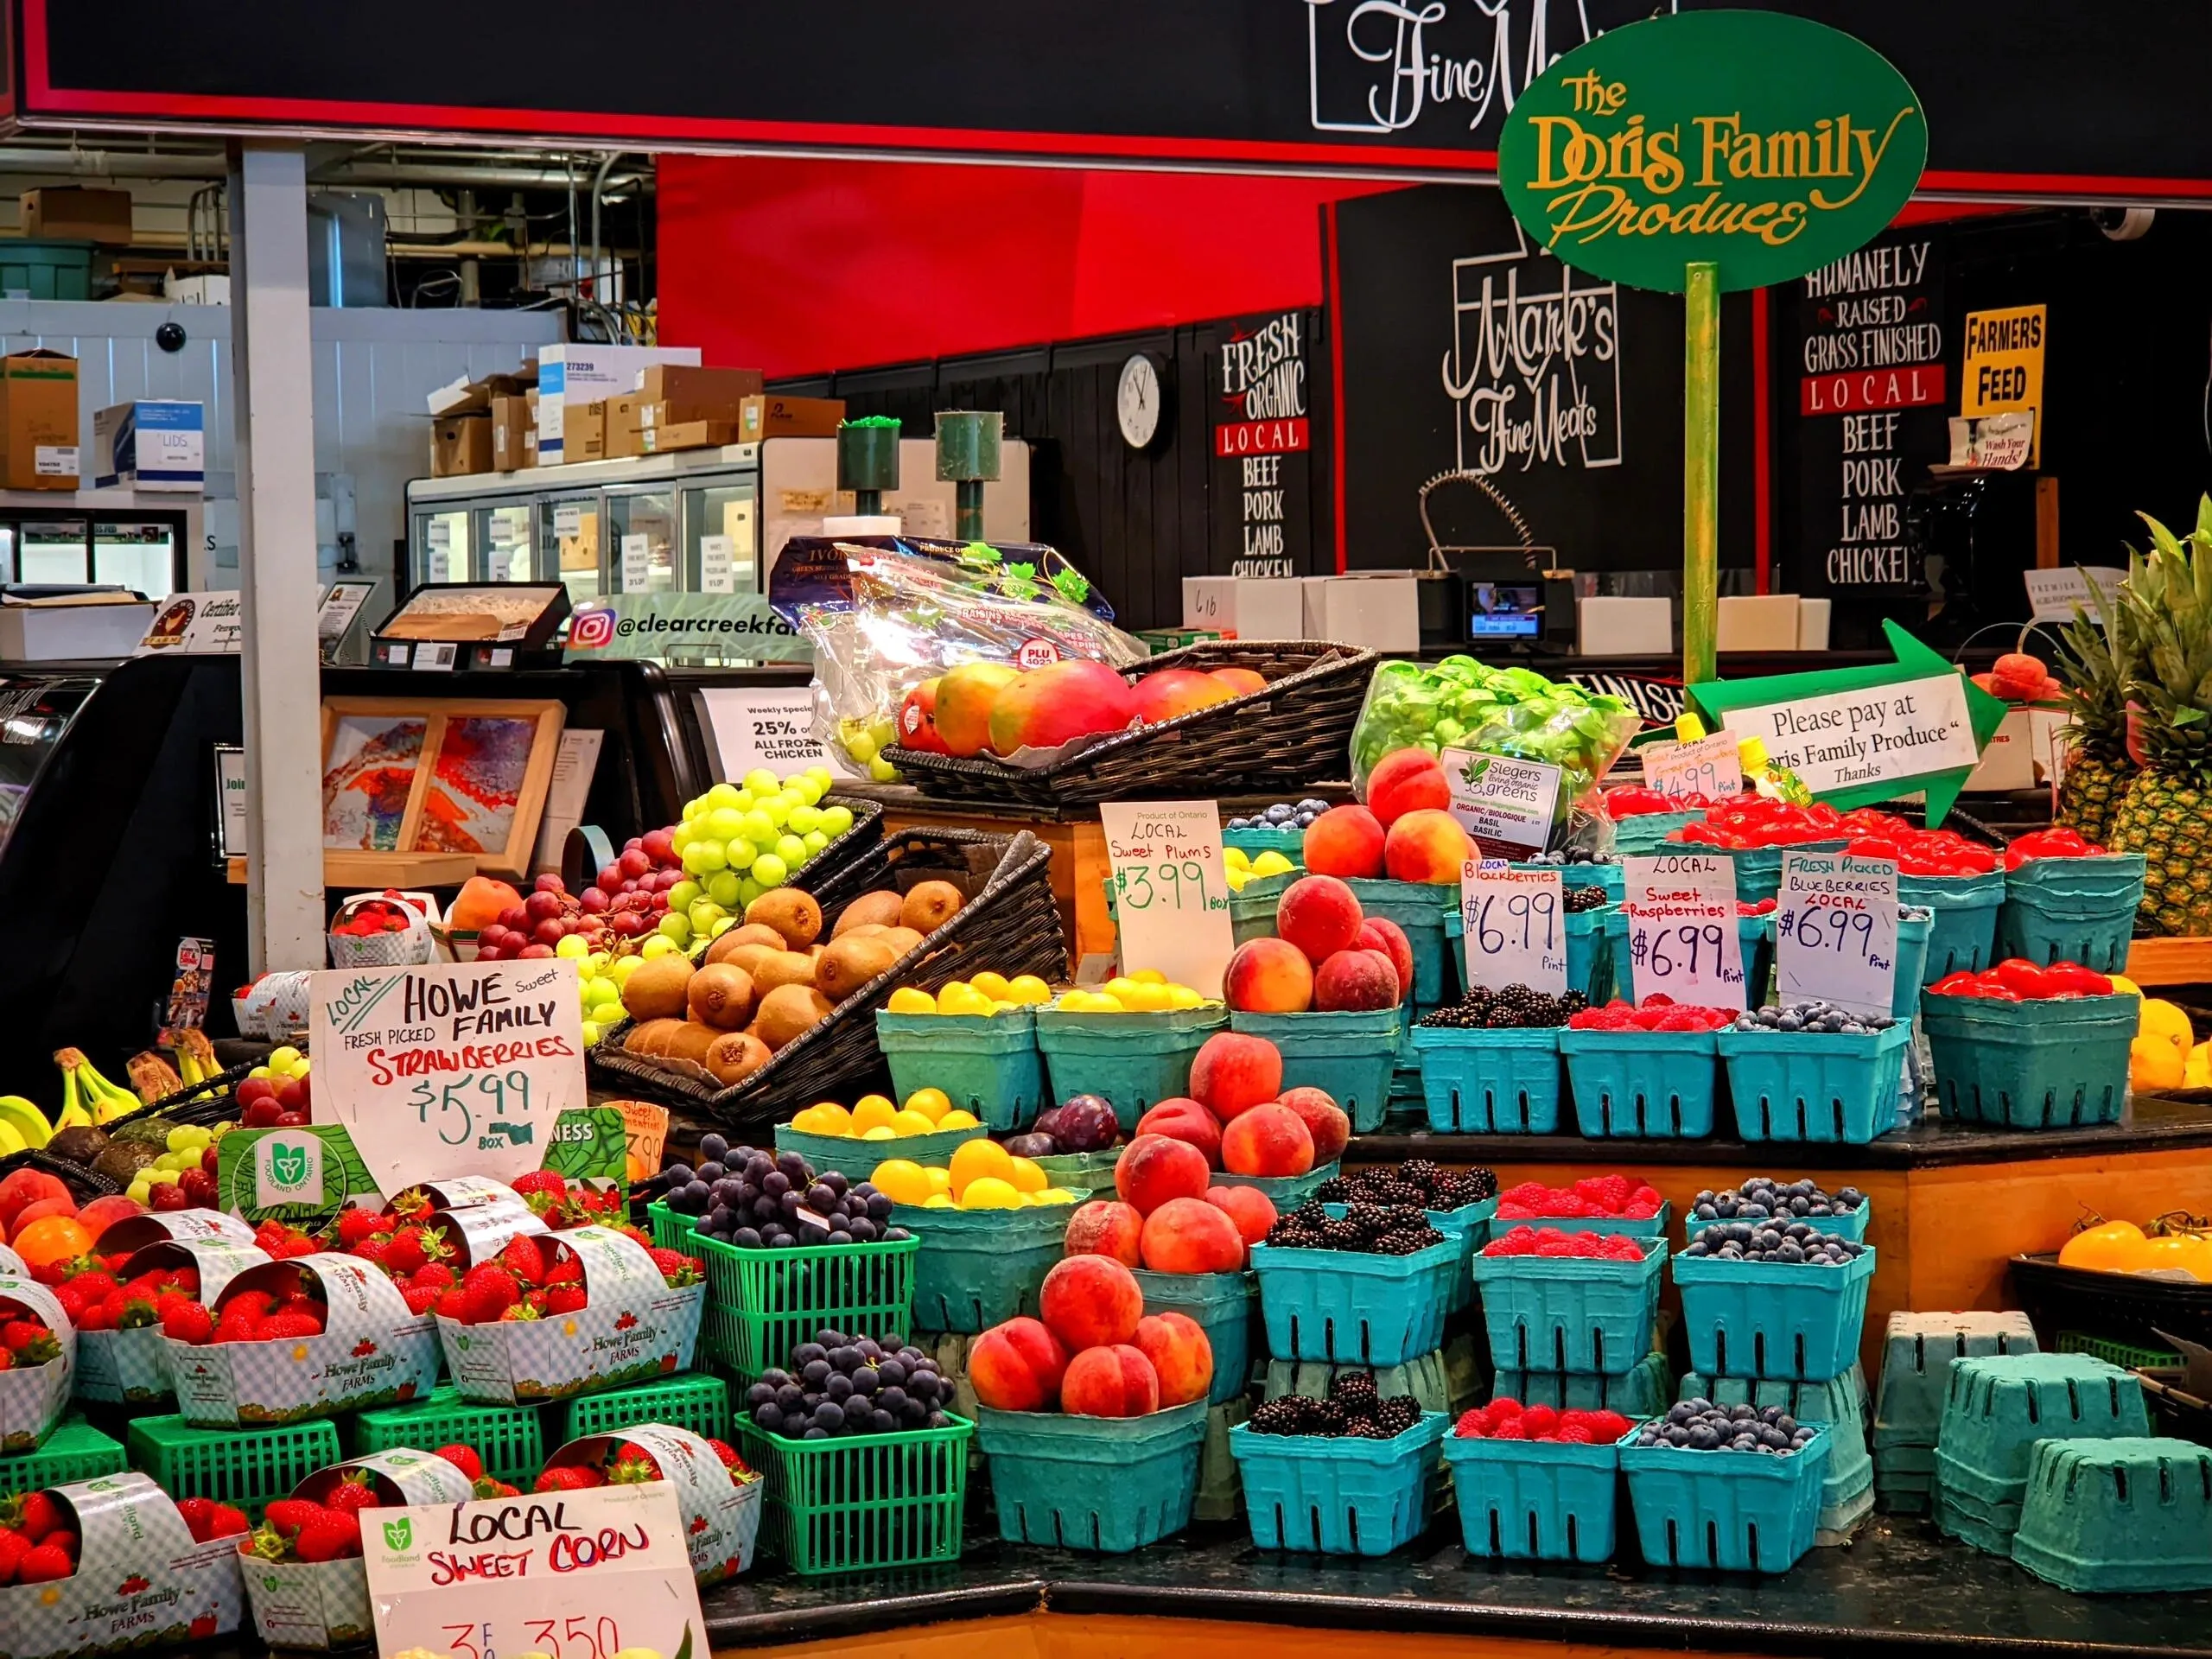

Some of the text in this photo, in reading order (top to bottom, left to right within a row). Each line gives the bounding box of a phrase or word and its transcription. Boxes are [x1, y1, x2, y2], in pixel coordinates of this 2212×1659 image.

[1348, 0, 1484, 129] Fine
[1562, 68, 1626, 116] The
[1528, 107, 1914, 210] Doris Family
[1547, 182, 1808, 249] Produce
[1805, 242, 1930, 298] HUMANELY
[1835, 296, 1906, 327] RAISED
[1441, 266, 1615, 400] Mark's
[1804, 324, 1942, 372] GRASS FINISHED
[1967, 315, 2042, 359] FARMERS
[566, 362, 594, 372] 273239
[1222, 312, 1300, 394] FRESH
[1246, 359, 1306, 421] ORGANIC
[1810, 371, 1928, 411] LOCAL
[1978, 366, 2026, 406] FEED
[1224, 422, 1299, 454] LOCAL
[1470, 372, 1598, 474] Fine Meats
[1842, 412, 1901, 454] BEEF
[162, 434, 188, 448] LIDS
[1985, 438, 2025, 451] Wash Your
[1243, 455, 1282, 487] BEEF
[1982, 450, 2023, 467] Hands!
[1841, 457, 1904, 499] PORK
[1243, 489, 1286, 522] PORK
[1840, 504, 1900, 543] LAMB
[1244, 525, 1285, 556] LAMB
[1027, 649, 1050, 659] PLU
[747, 706, 781, 715] Weekly
[1771, 694, 1917, 736] Please pay at
[753, 721, 797, 735] 25%
[754, 741, 777, 750] ALL
[764, 747, 823, 760] CHICKEN
[1670, 739, 1728, 761] Product of Ontario
[1803, 736, 1867, 766] Family
[1872, 725, 1949, 753] Produce
[1488, 774, 1539, 790] living organic
[1489, 761, 1542, 782] Slegers
[1834, 763, 1882, 783] Thanks
[1485, 782, 1538, 802] greens
[1137, 811, 1167, 820] Product
[1178, 810, 1208, 819] Ontario
[1478, 817, 1500, 828] BASIL
[1131, 822, 1188, 841] LOCAL
[1473, 825, 1503, 837] BASILIC
[1111, 840, 1211, 860] Sweet Plums
[1653, 855, 1718, 874] LOCAL
[1479, 861, 1508, 871] LOCAL
[1788, 860, 1835, 874] FRESH
[1115, 861, 1207, 912] $3.99
[1647, 887, 1701, 902] Sweet
[1790, 878, 1891, 894] BLUEBERRIES
[1804, 893, 1867, 910] LOCAL
[1465, 892, 1555, 954] $6.99
[1629, 902, 1726, 921] Raspberries
[1780, 906, 1873, 957] $6.99
[1630, 925, 1724, 977] $6.99
[326, 975, 381, 1026] LOCAL
[404, 969, 560, 1025] HOWE Sweet
[453, 1000, 556, 1041] FAMILY
[344, 1027, 435, 1051] FRESH PICKED
[367, 1035, 575, 1086] STRAWBERRIES
[407, 1070, 530, 1146] $5.99
[478, 1135, 504, 1150] BOX
[264, 1156, 314, 1193] FOODLAND ONTARIO
[592, 1326, 659, 1352] Howe Family
[323, 1353, 398, 1379] Howe Family
[609, 1347, 640, 1365] FARMS
[342, 1374, 376, 1393] FARMS
[449, 1501, 583, 1545] LOCAL
[381, 1553, 422, 1564] Foodland
[427, 1522, 651, 1586] SWEET CORN
[83, 1586, 182, 1623] Howe Family
[111, 1611, 156, 1635] FARMS
